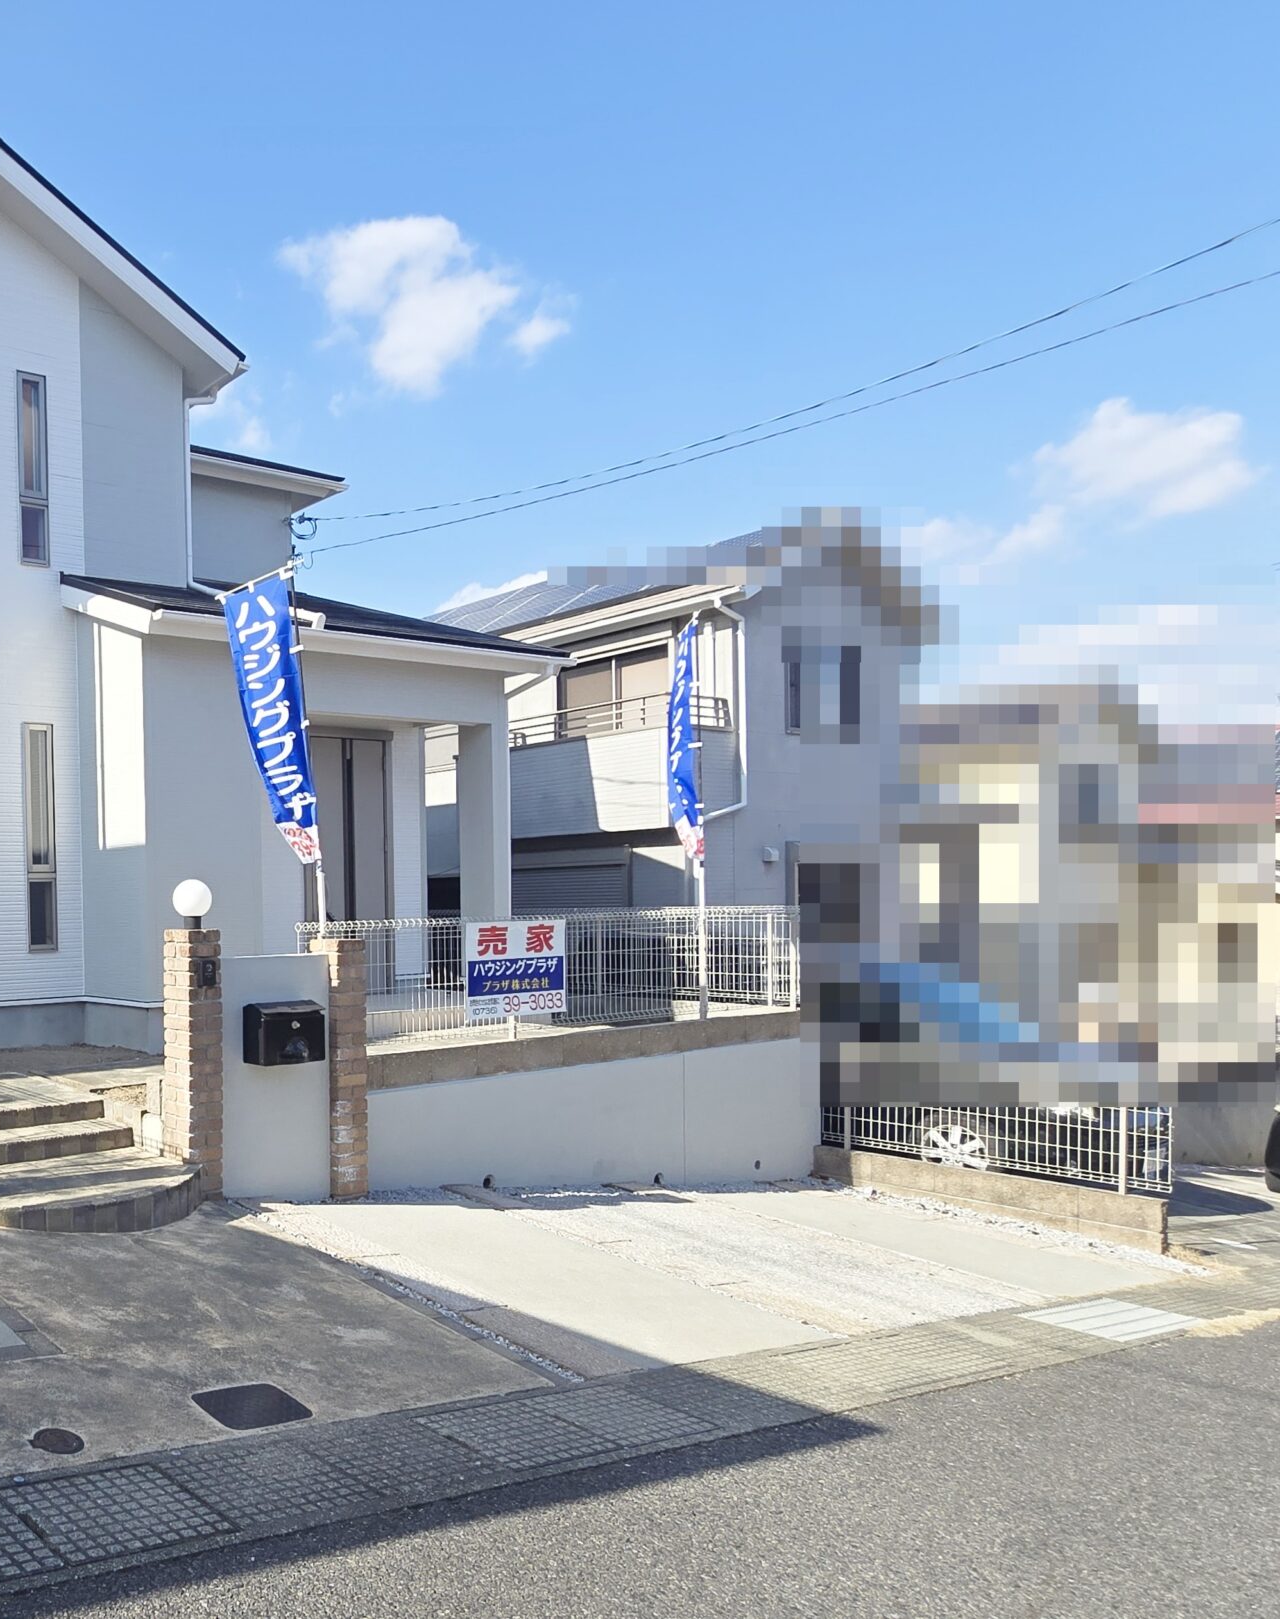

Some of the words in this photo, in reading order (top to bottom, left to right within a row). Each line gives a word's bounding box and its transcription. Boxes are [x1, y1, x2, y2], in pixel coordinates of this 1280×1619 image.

[235, 594, 317, 821] ハウジングプラザ
[476, 924, 555, 957] 売家
[473, 957, 558, 977] ハウジングプラザ
[502, 991, 563, 1013] 39-3033
